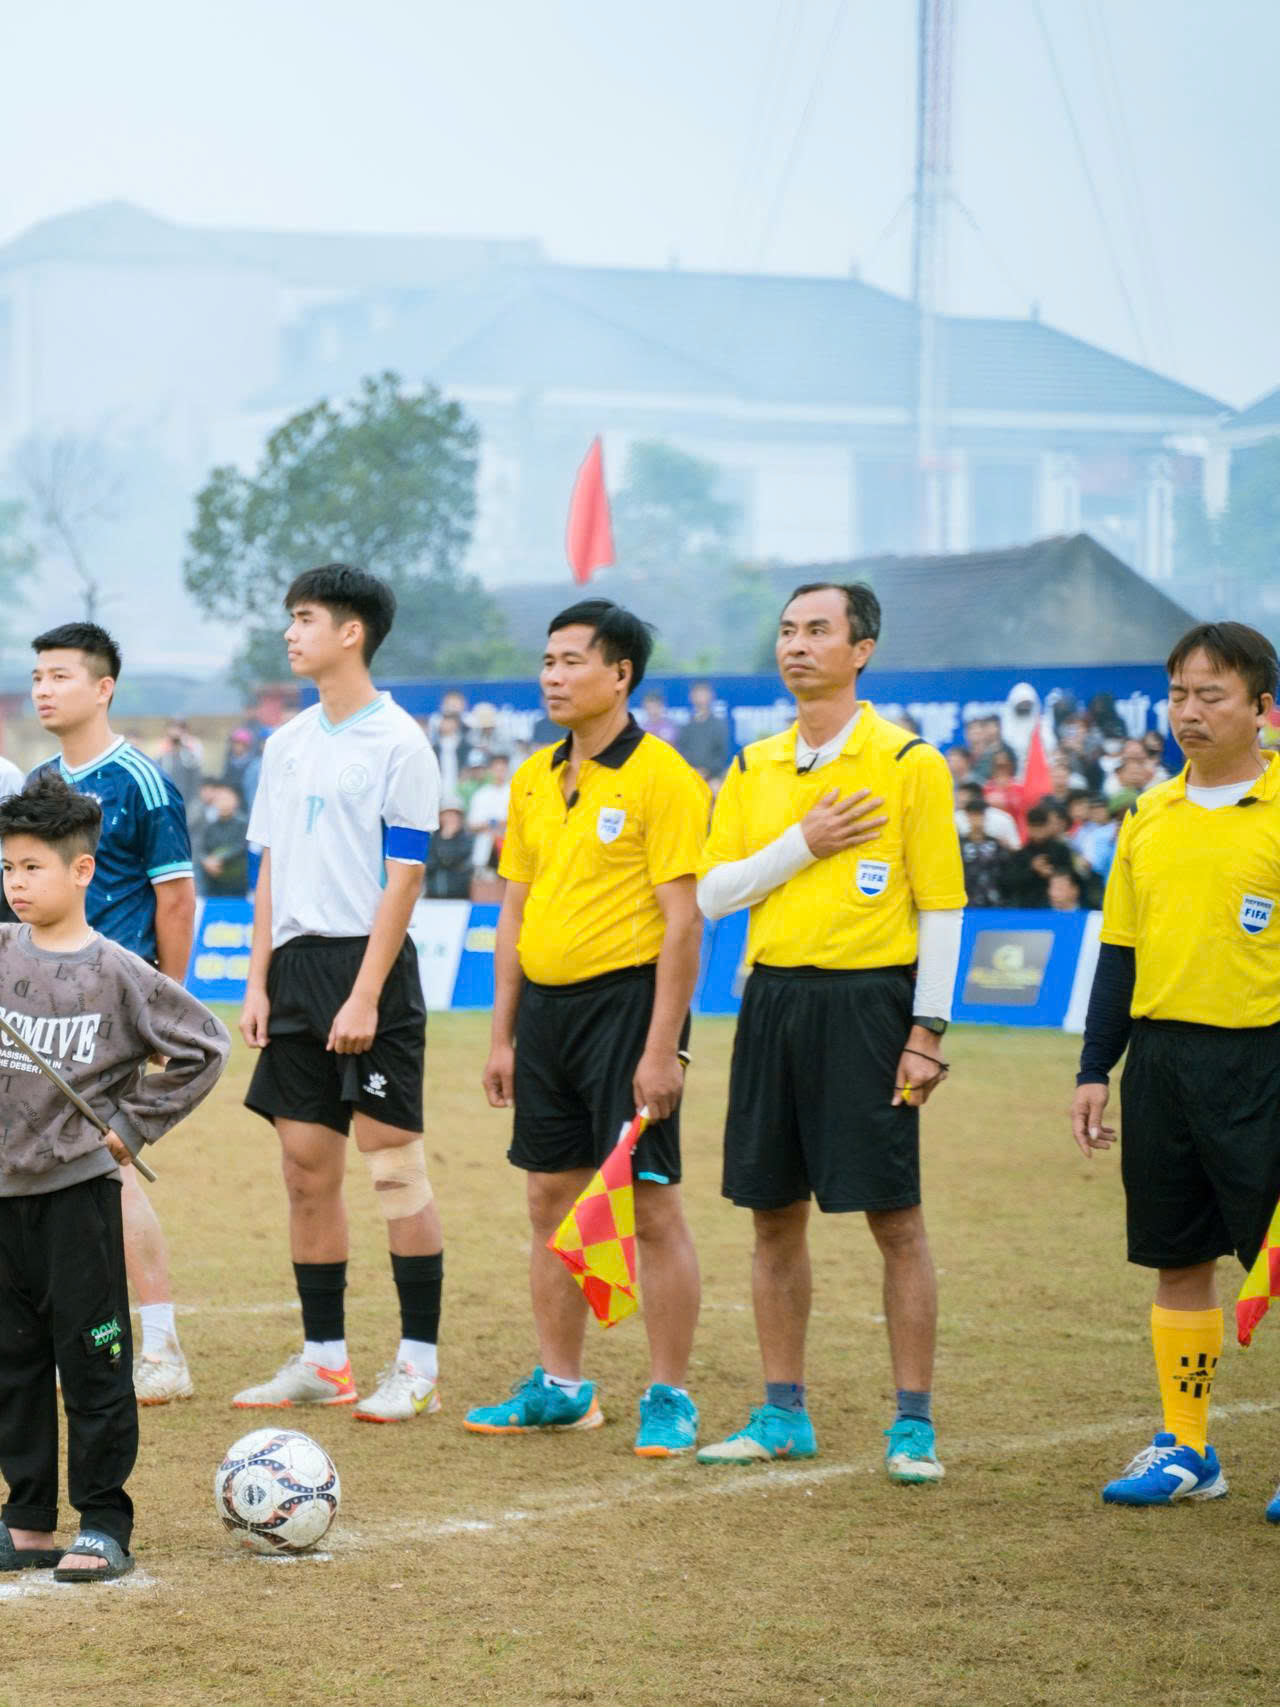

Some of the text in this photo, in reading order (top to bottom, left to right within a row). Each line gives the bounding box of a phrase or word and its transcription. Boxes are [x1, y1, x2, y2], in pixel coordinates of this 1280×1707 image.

[860, 872, 883, 882] FIFA
[1245, 907, 1268, 921] FIFA
[74, 1536, 105, 1551] EVA
